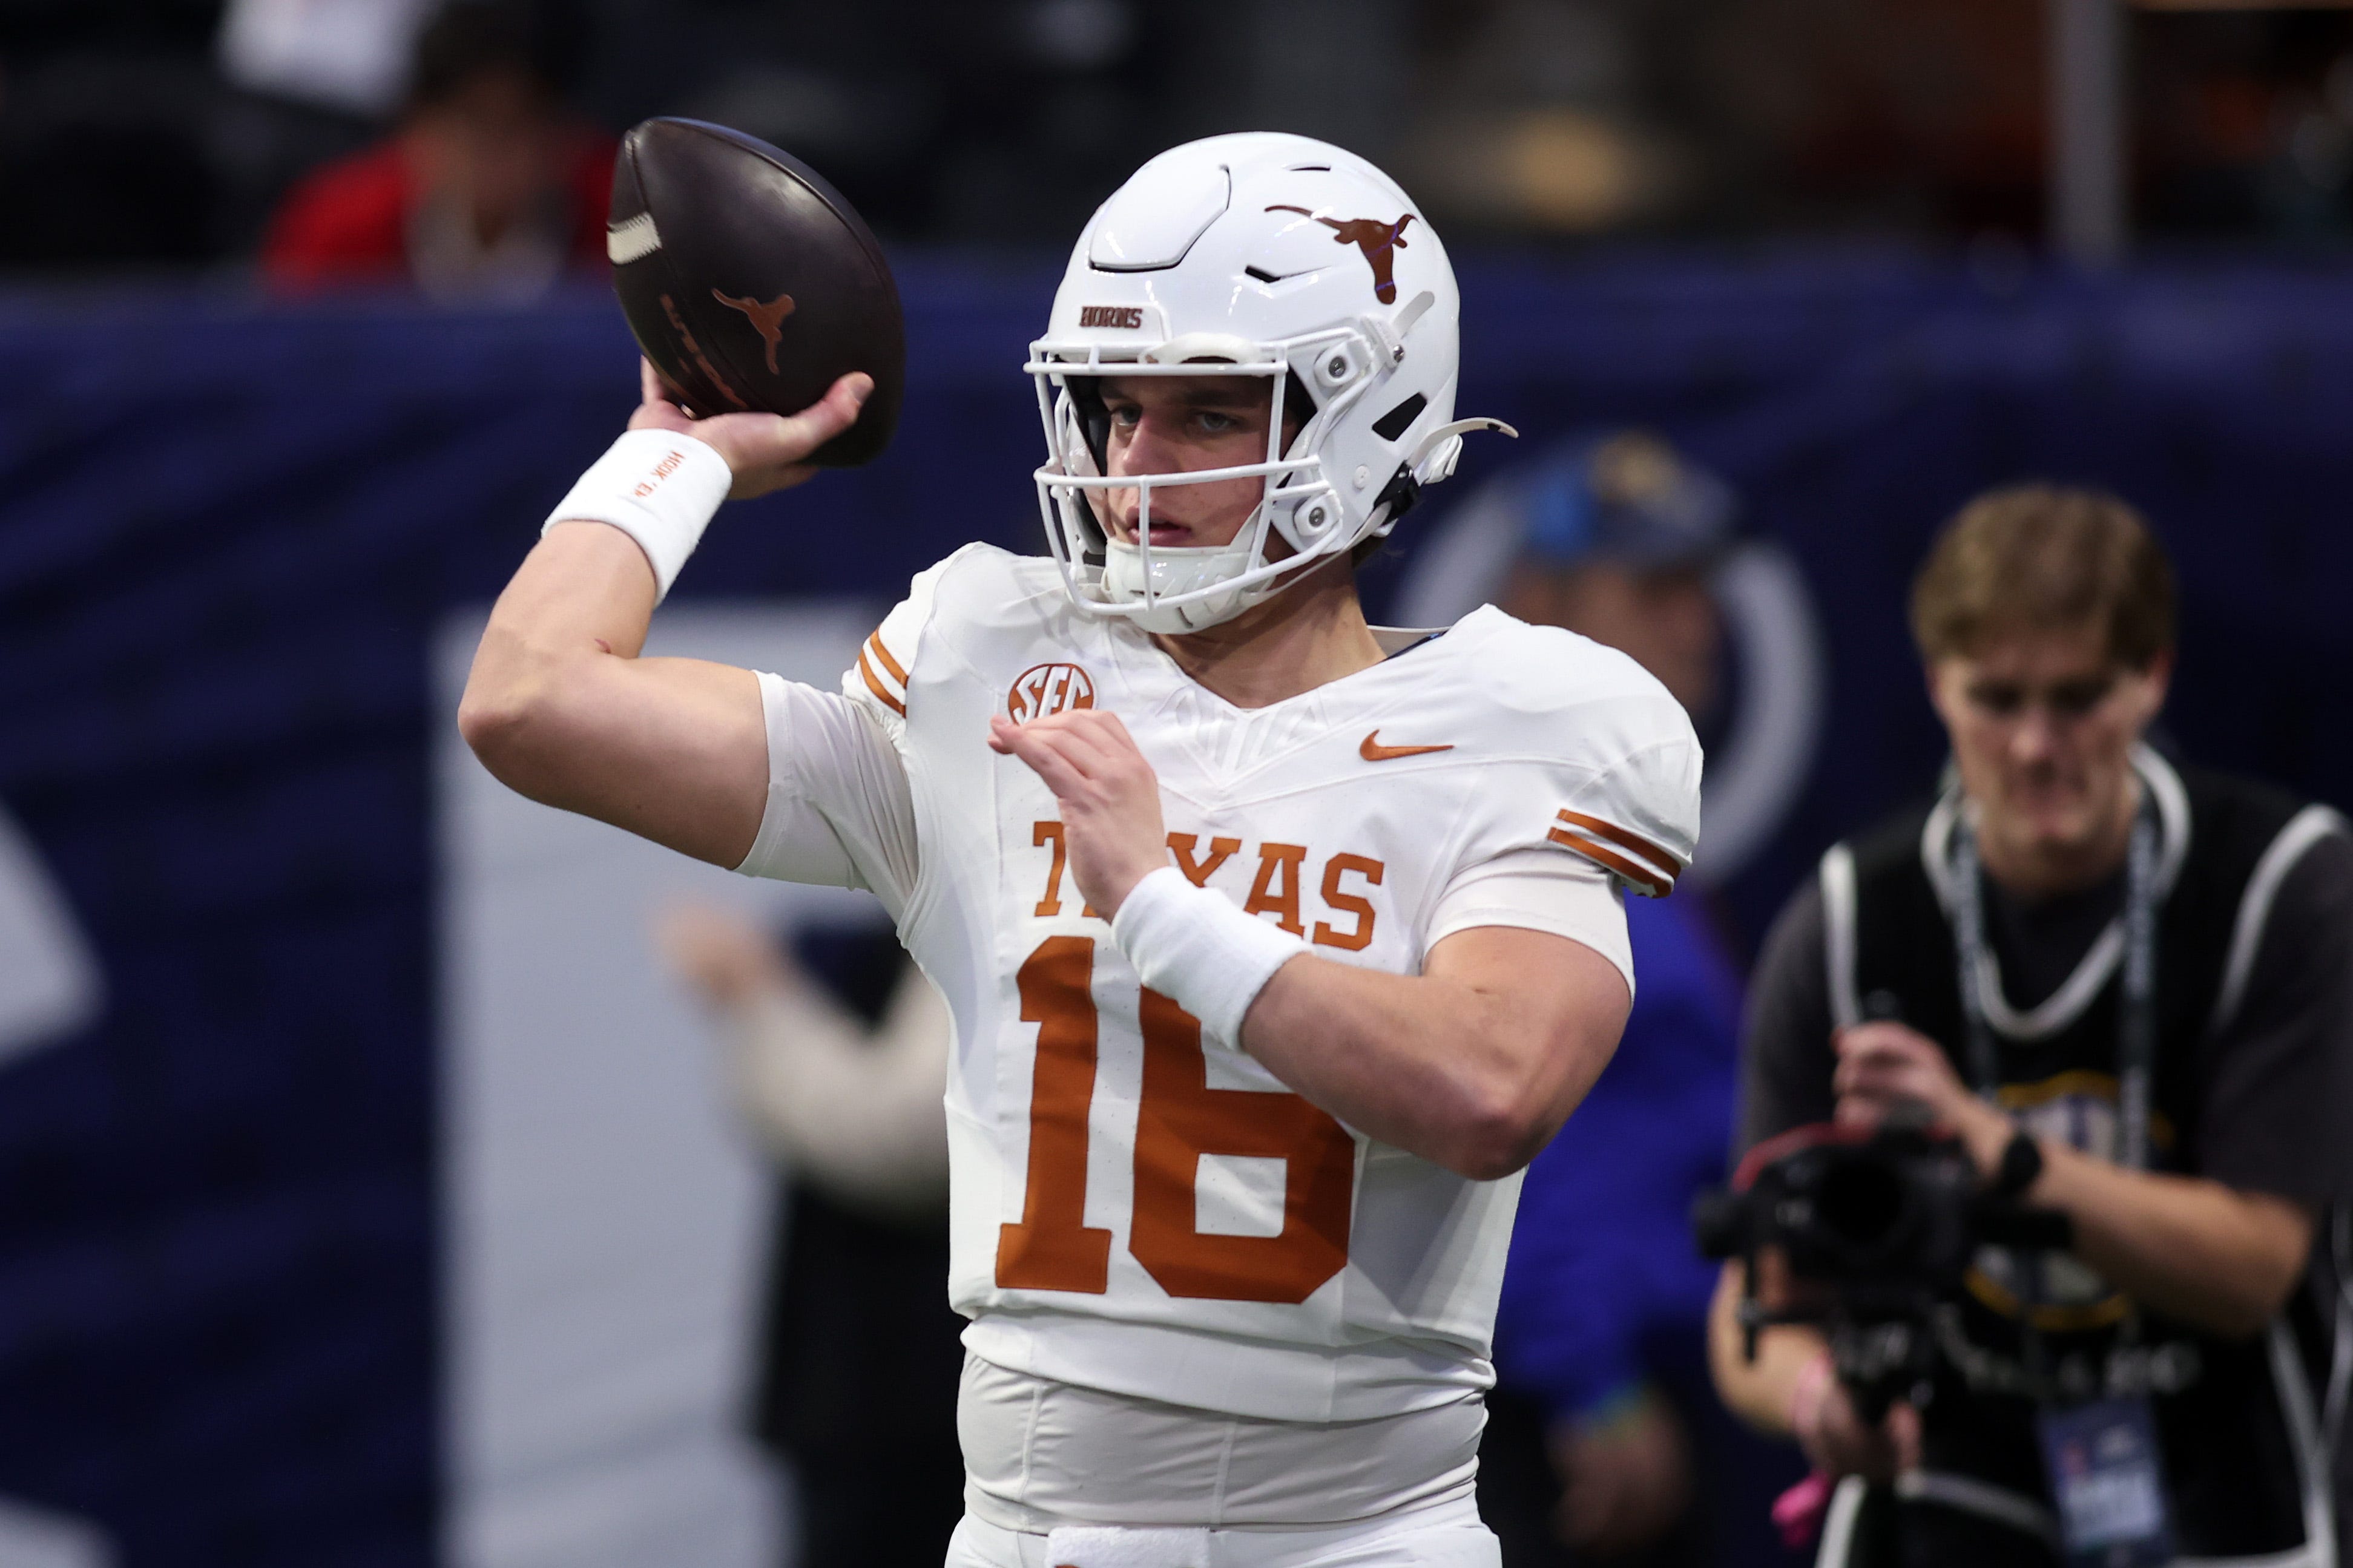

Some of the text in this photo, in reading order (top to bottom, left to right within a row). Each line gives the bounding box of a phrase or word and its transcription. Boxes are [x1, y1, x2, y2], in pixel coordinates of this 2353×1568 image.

[1079, 306, 1143, 329] HORNS
[650, 450, 685, 481] HOOK
[1033, 821, 1384, 951] TXAS
[995, 936, 1355, 1304] 16
